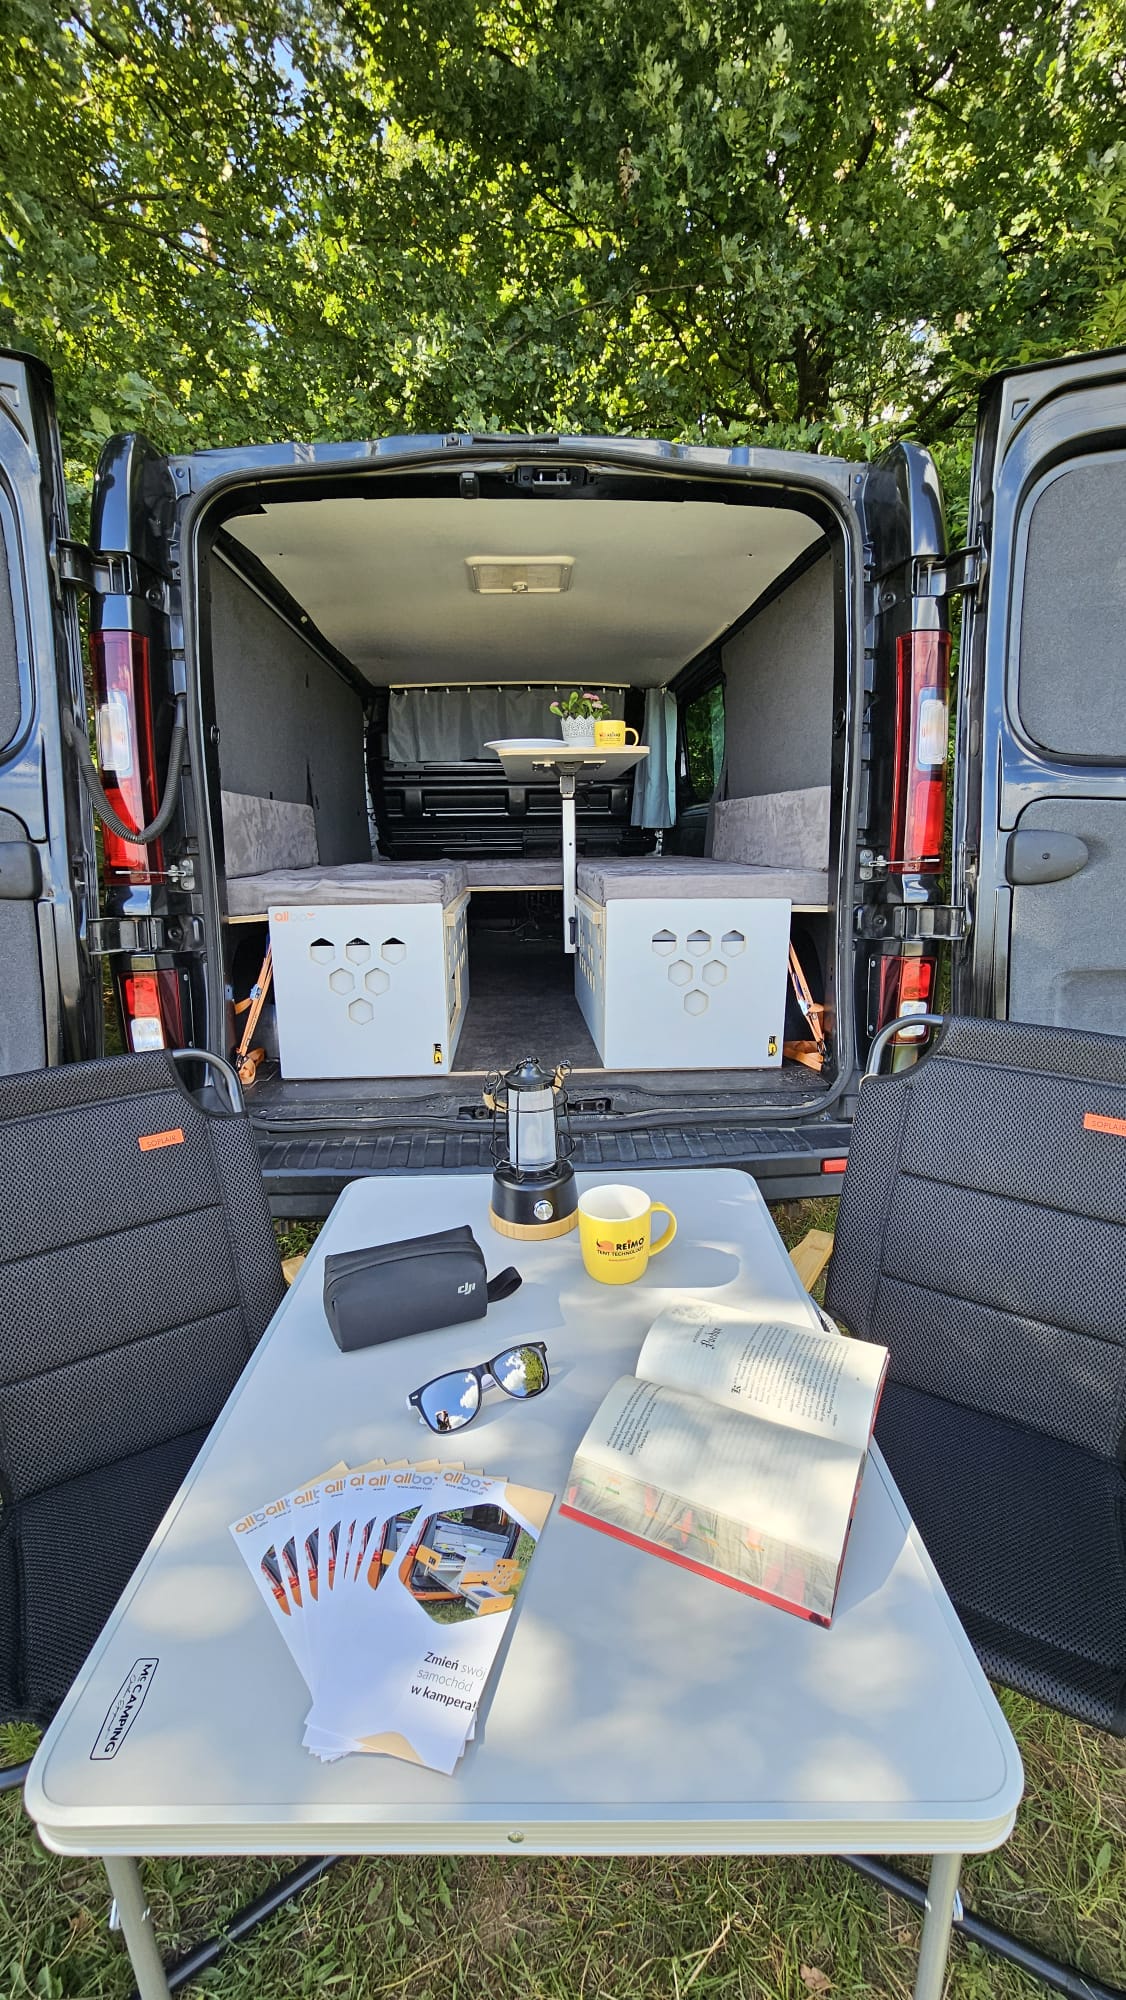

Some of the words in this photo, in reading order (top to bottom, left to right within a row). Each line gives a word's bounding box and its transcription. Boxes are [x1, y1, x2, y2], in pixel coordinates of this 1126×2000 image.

[443, 1471, 489, 1492] allbox
[423, 1651, 459, 1671] Zmień
[460, 1664, 488, 1681] swój
[416, 1669, 474, 1693] samochód
[411, 1685, 422, 1696] w
[422, 1685, 477, 1713] kampera!
